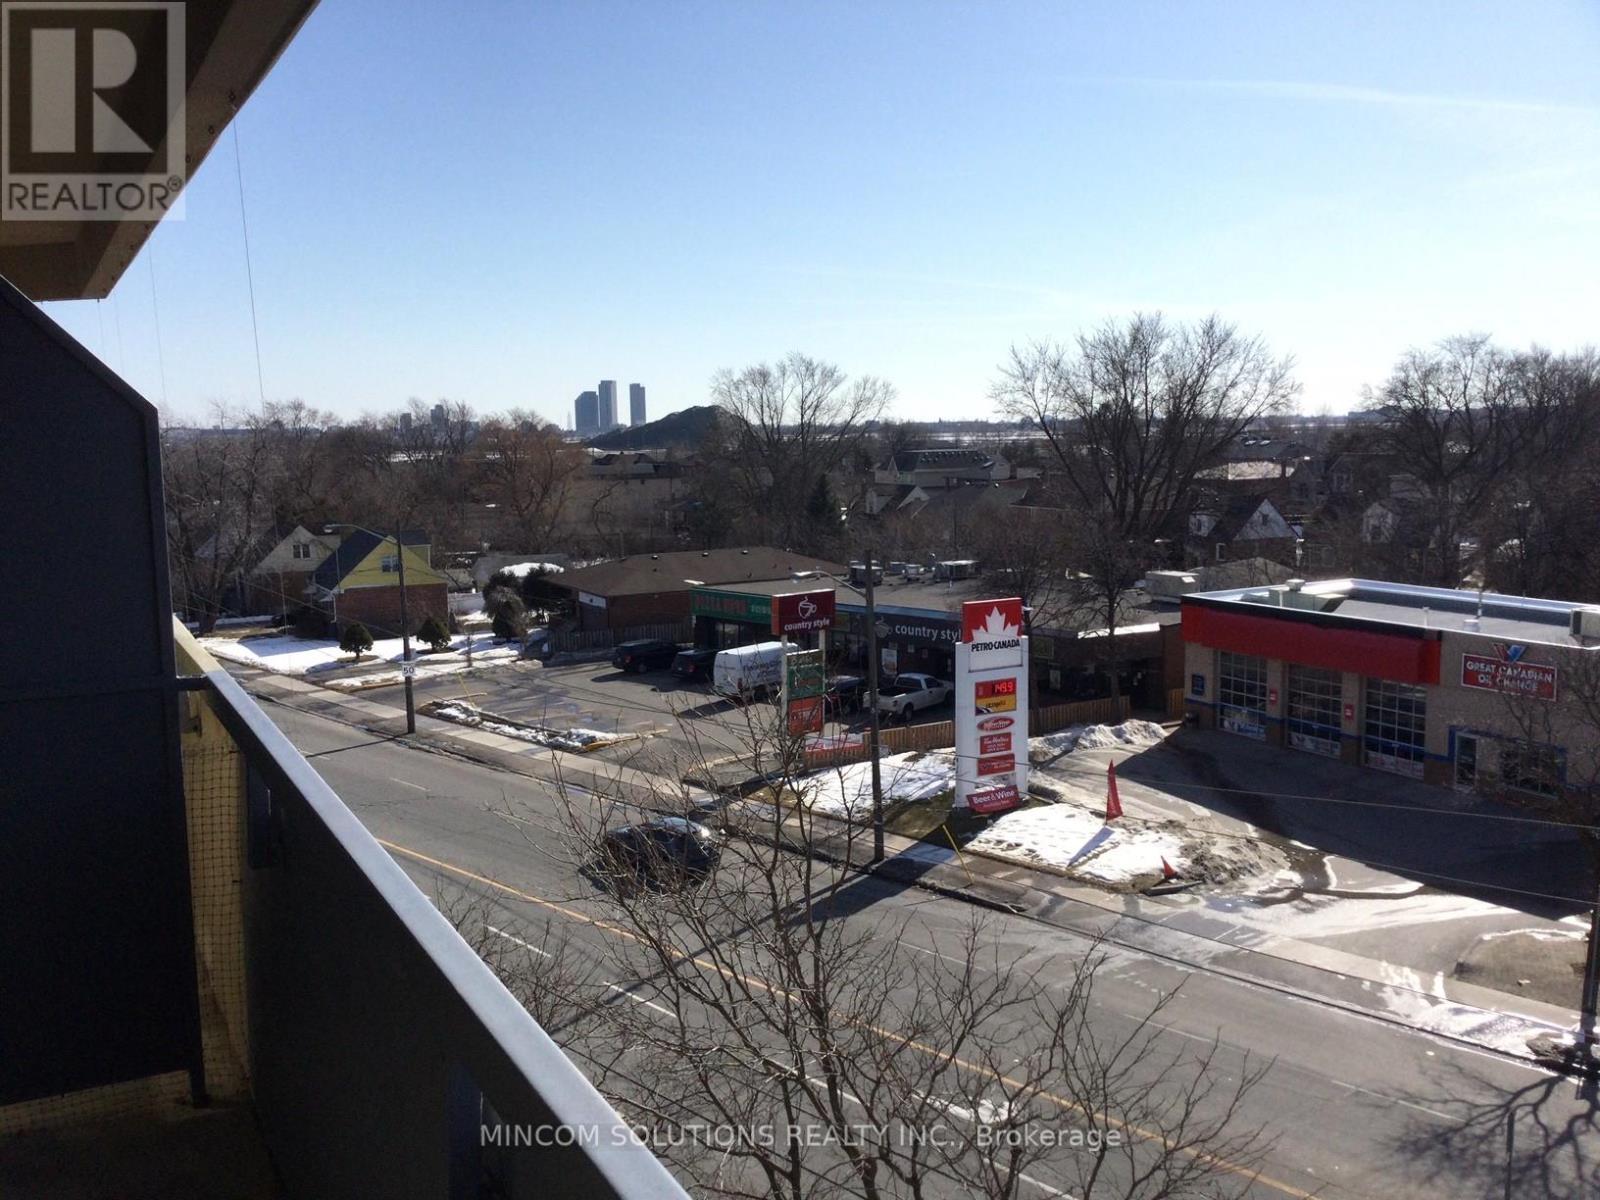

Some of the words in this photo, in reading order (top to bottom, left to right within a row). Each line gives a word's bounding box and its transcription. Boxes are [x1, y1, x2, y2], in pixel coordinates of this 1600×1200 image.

[784, 621, 812, 631] country
[813, 617, 830, 628] style
[895, 624, 938, 641] country
[940, 629, 962, 643] styl
[403, 666, 415, 674] 50
[1466, 661, 1496, 674] GREAT
[972, 794, 991, 804] Beer
[995, 790, 1015, 800] Wine
